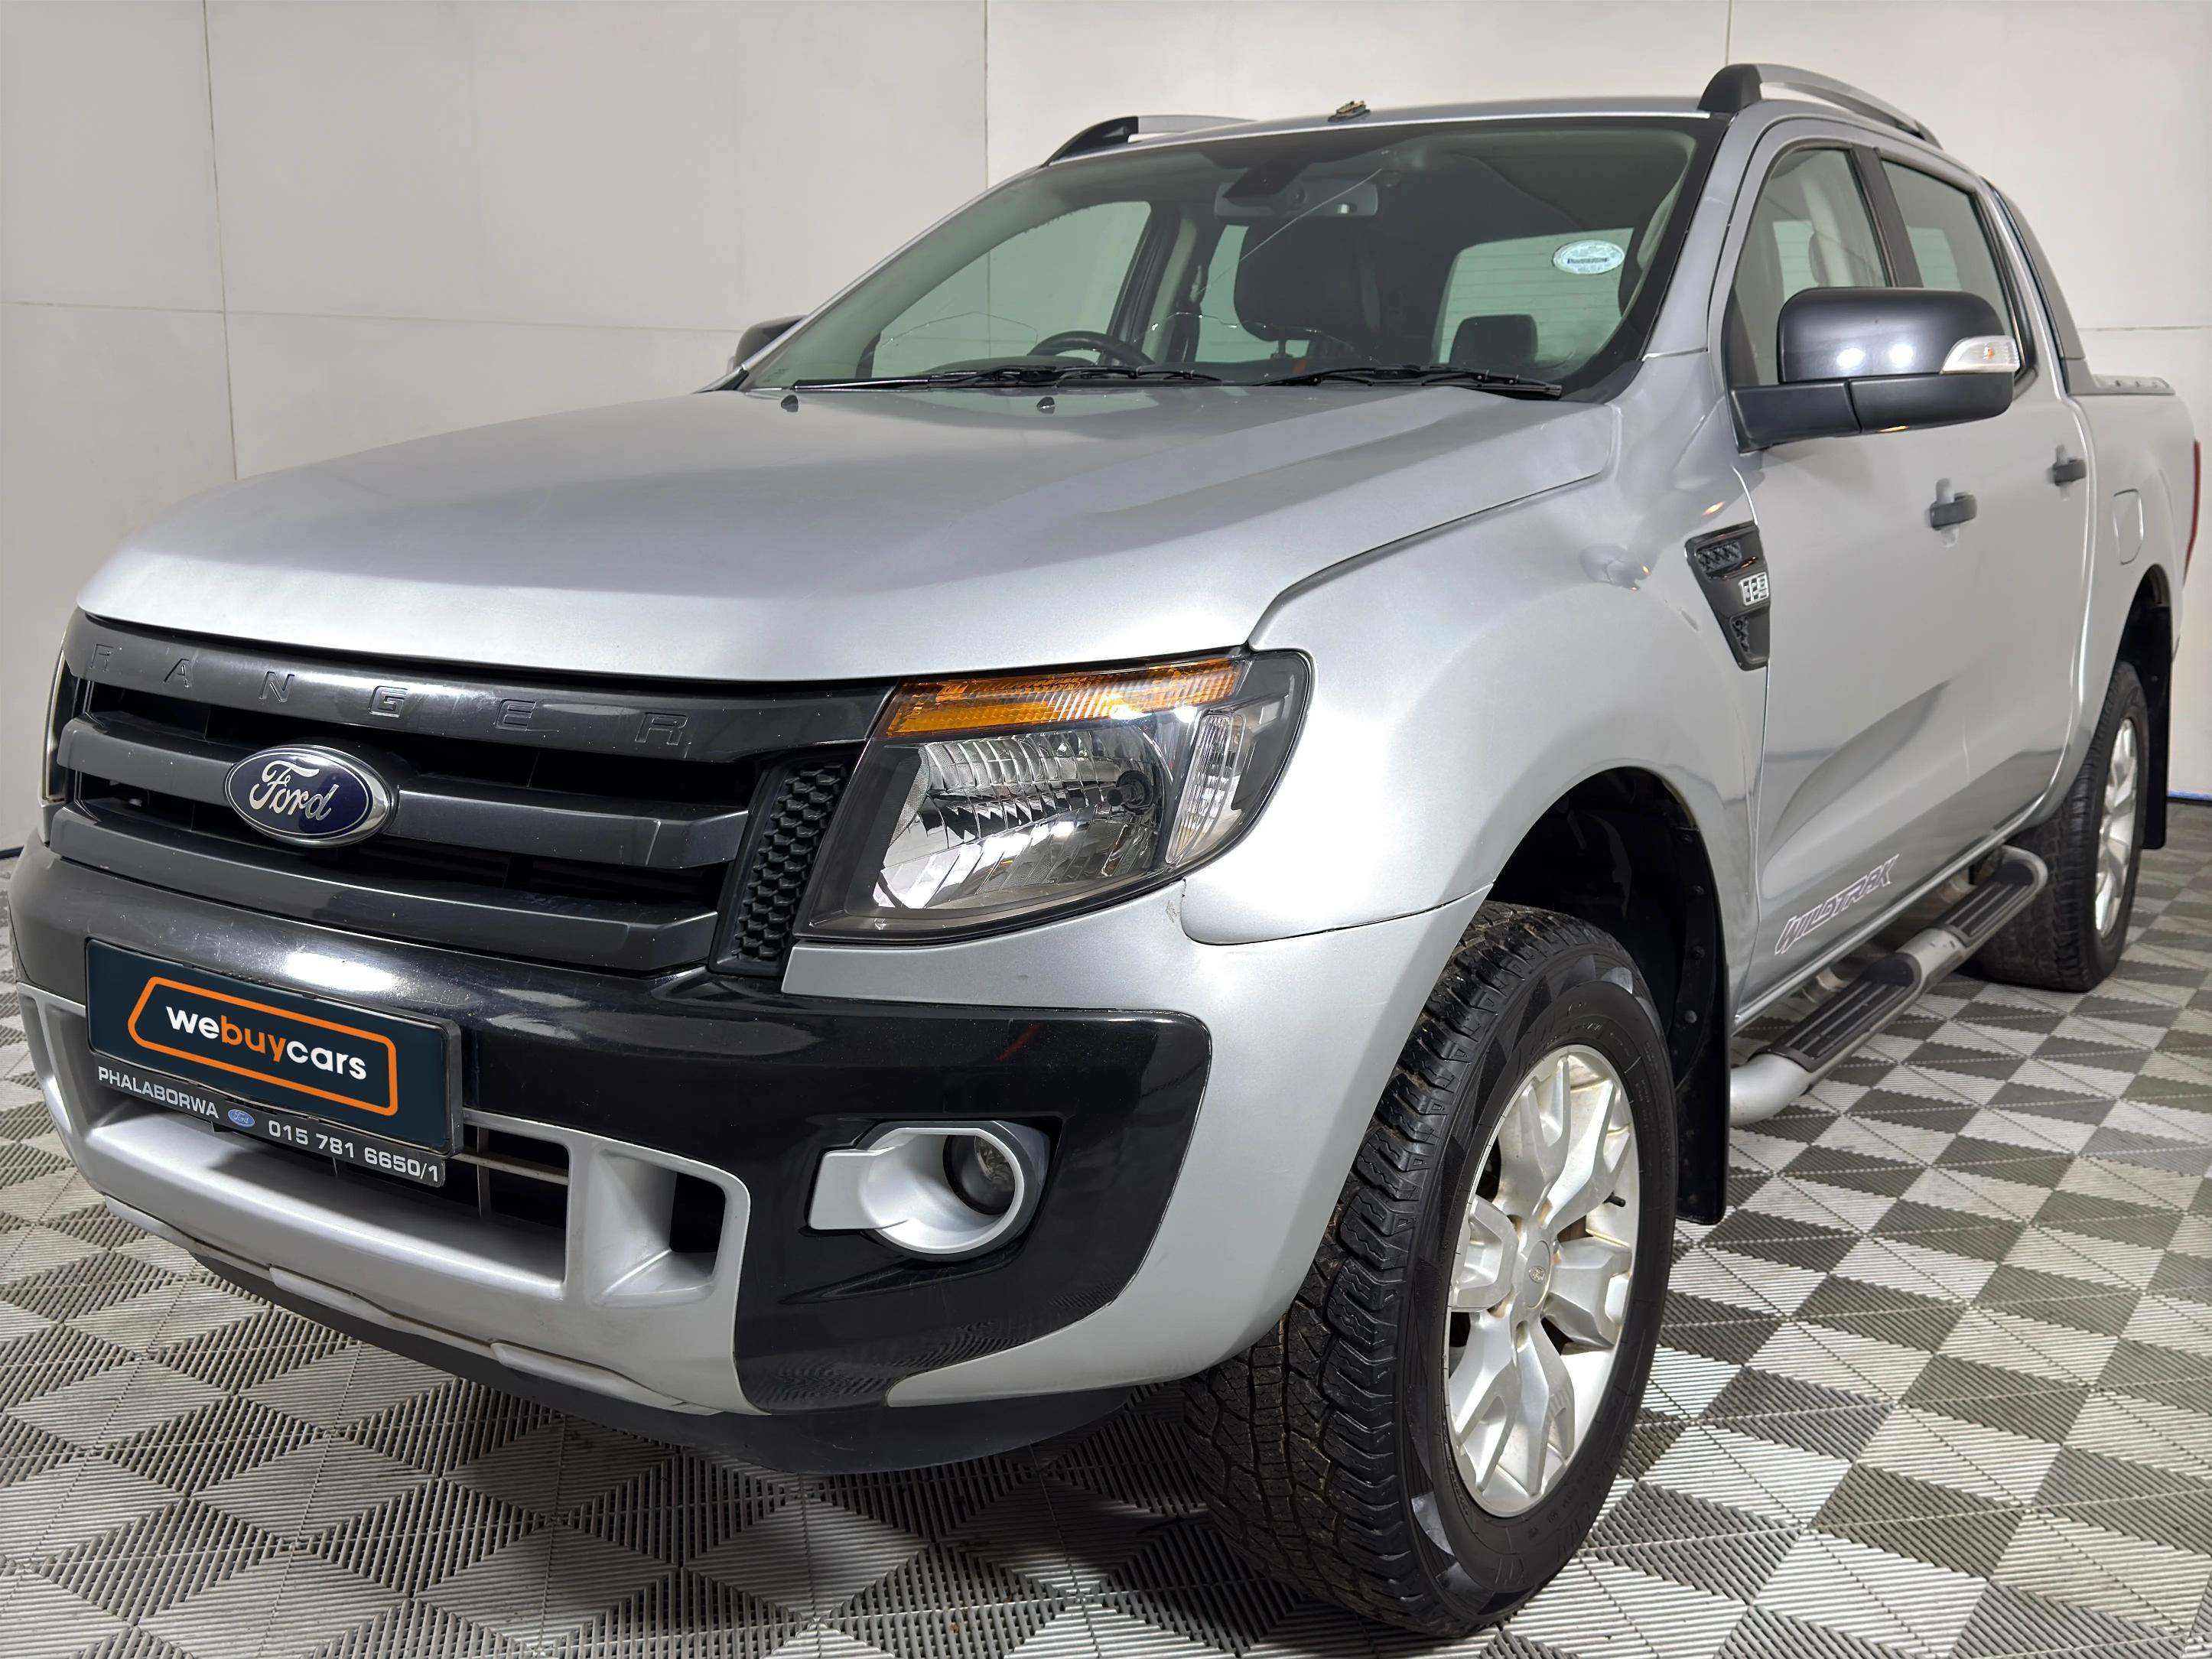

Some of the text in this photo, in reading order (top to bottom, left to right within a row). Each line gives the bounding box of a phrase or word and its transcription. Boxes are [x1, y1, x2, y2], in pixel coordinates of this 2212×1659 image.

[89, 644, 689, 745] RANGER
[249, 760, 340, 821] Ford
[1774, 854, 1900, 955] WILDTRAK
[166, 1006, 367, 1080] webuycars
[98, 1066, 219, 1119] PHALABORWA
[268, 1120, 439, 1182] 015 781 6650/1
